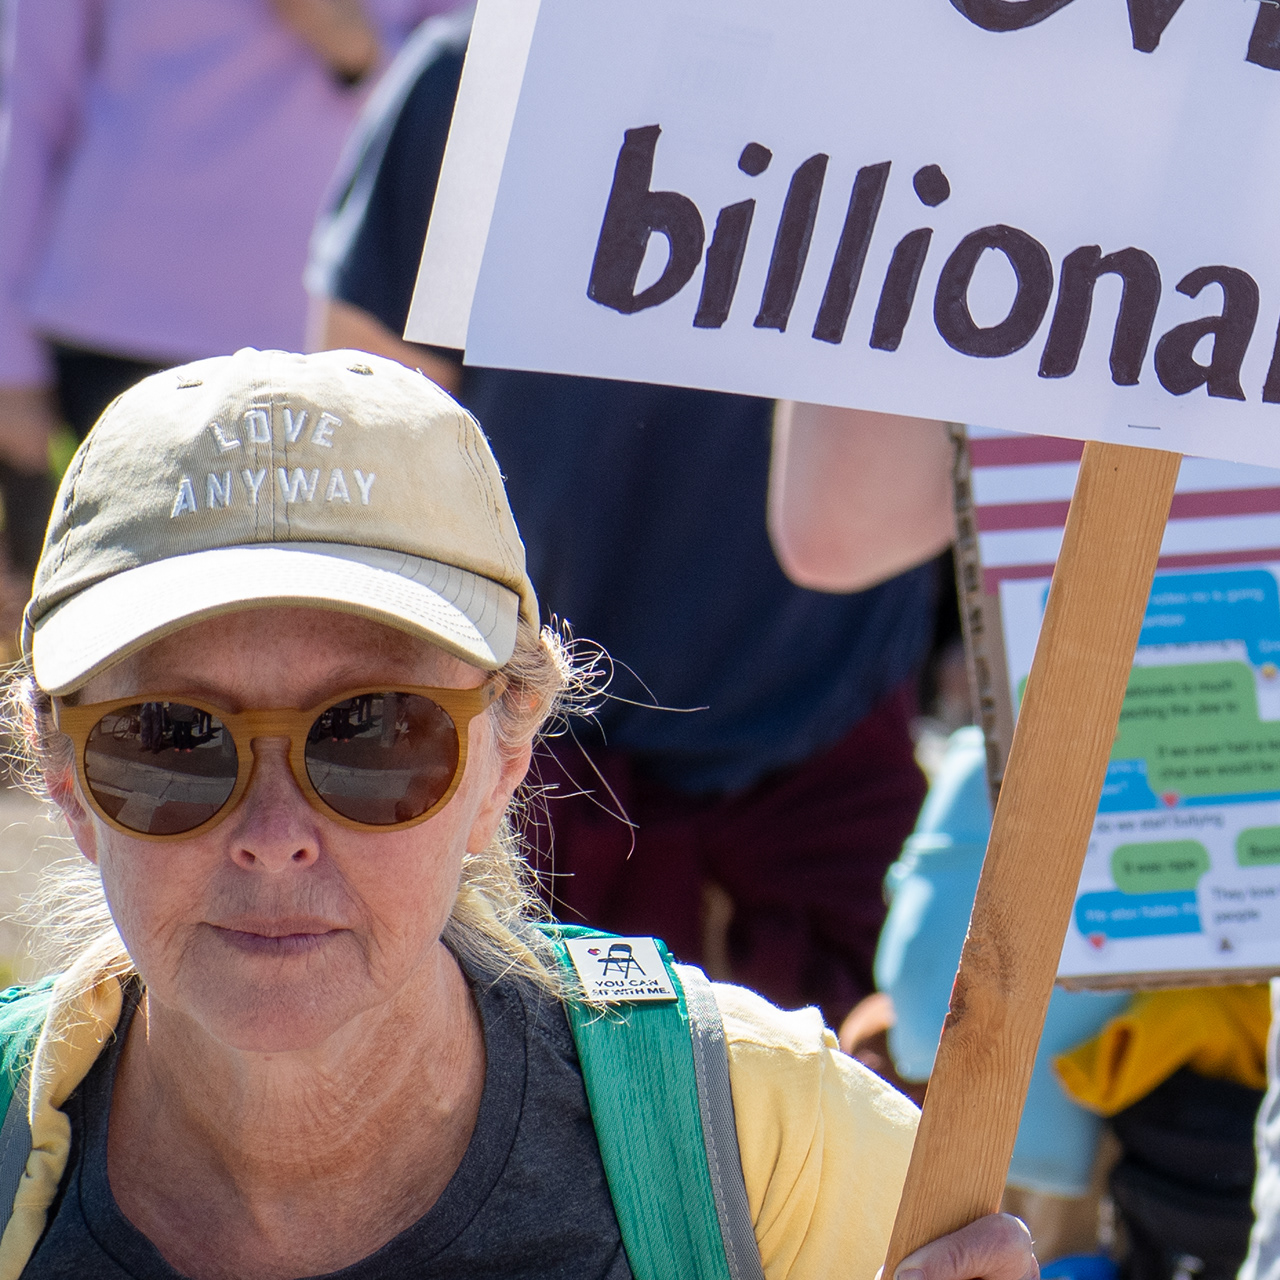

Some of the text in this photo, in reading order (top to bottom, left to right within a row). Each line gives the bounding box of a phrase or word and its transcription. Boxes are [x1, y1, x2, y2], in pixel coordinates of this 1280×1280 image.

[207, 407, 343, 453] LOVE
[170, 466, 377, 520] ANYWAY
[594, 978, 659, 988] YOU CAN
